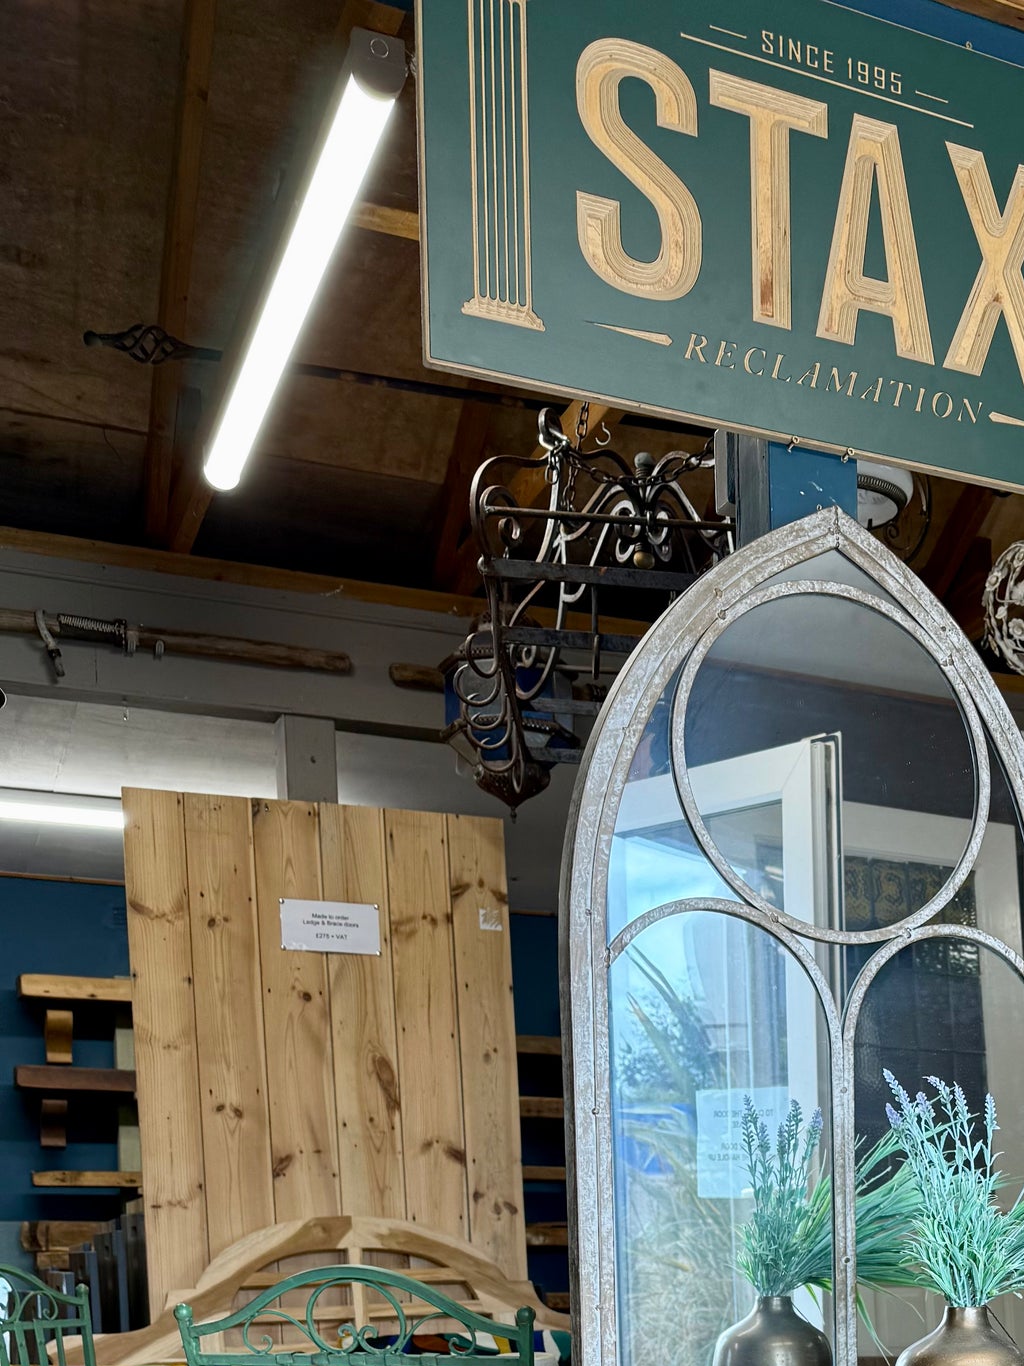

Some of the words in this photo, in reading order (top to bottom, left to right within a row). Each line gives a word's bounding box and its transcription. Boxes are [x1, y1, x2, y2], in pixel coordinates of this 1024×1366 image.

[761, 30, 834, 75] SINCE
[847, 56, 903, 96] 1995
[684, 332, 985, 426] RECLAMATION
[311, 912, 328, 920] Made
[335, 933, 348, 941] VAT
